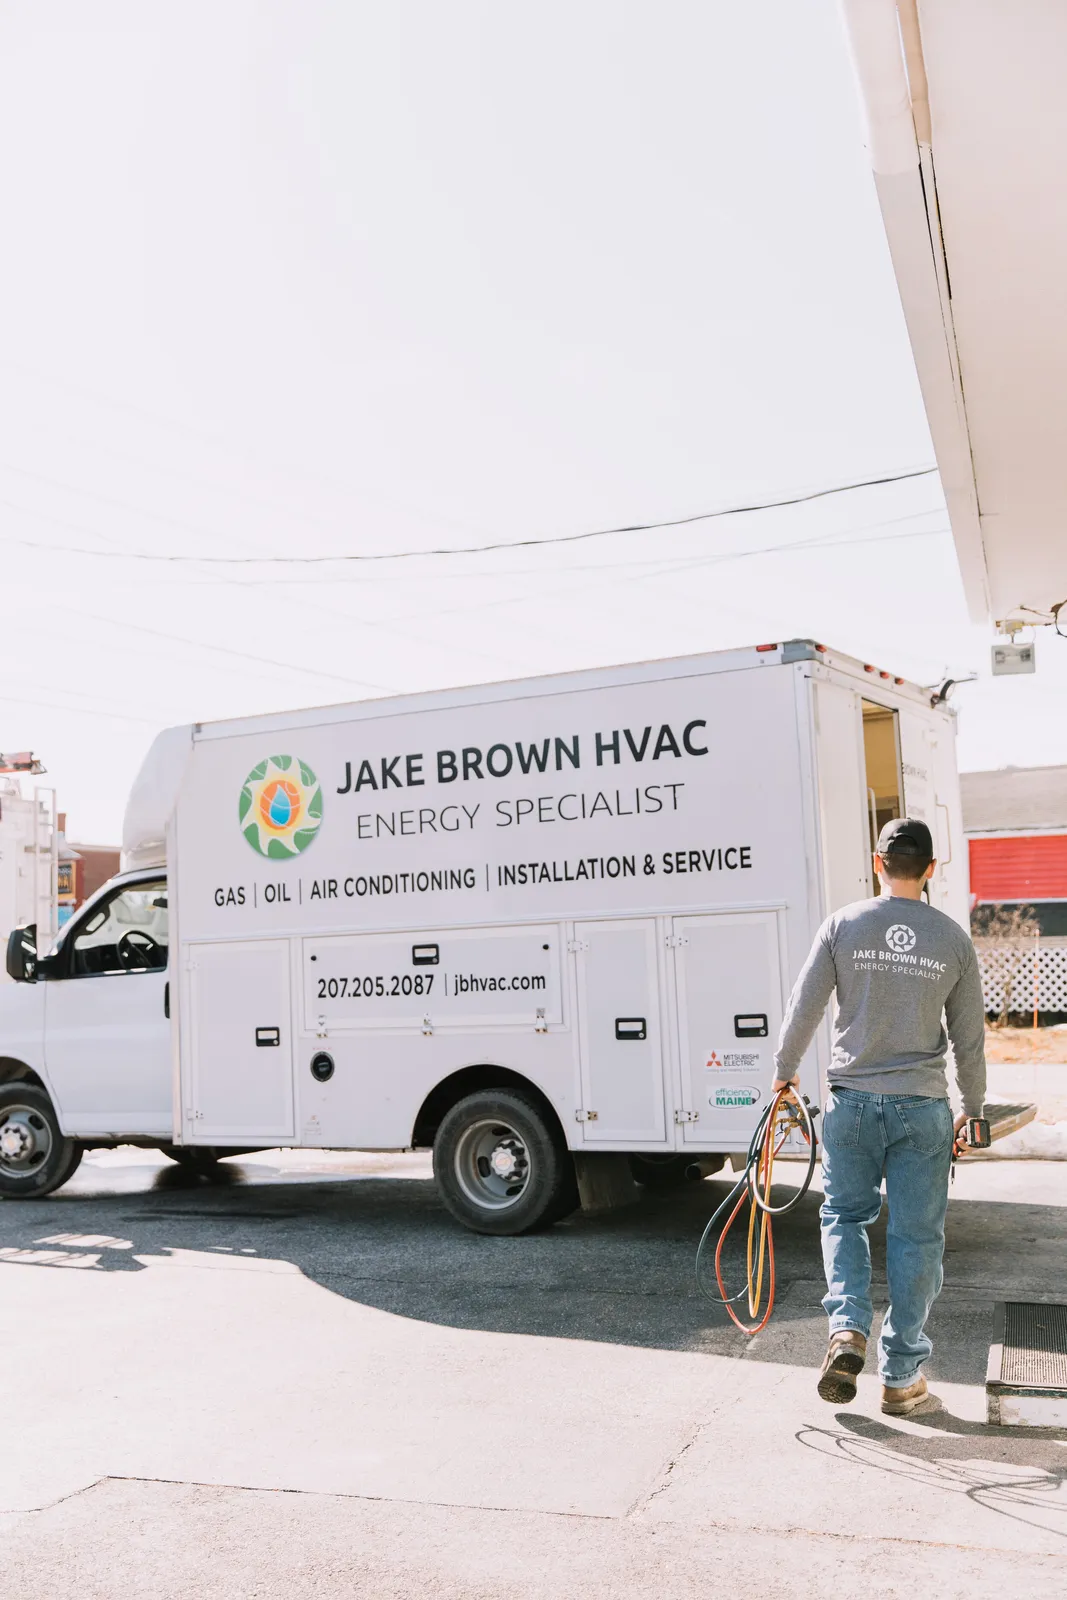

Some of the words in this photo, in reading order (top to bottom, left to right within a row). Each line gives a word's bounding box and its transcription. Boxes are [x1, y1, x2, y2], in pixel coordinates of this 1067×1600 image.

[336, 753, 425, 795] JAKE
[436, 734, 581, 784] BROWN
[594, 719, 709, 767] HVAC
[357, 803, 481, 840] ENERGY
[495, 782, 686, 828] SPECIALIST
[214, 886, 246, 907] GAS
[264, 882, 292, 904] OIL
[310, 878, 339, 900] AIR
[343, 867, 476, 898] CONDITIONING
[497, 856, 637, 887] INSTALLATION
[642, 853, 656, 876] &
[662, 845, 753, 875] SERVICE
[852, 949, 877, 960] JAKE
[878, 950, 918, 965] BROWN
[919, 956, 947, 973] HVAC
[854, 962, 890, 972] ENERGY
[892, 965, 942, 981] SPECIALIST
[317, 973, 435, 999] 207.205.2087
[453, 973, 546, 998] jbhvac.com
[715, 1088, 752, 1096] efficiency
[716, 1097, 752, 1105] MAINE
